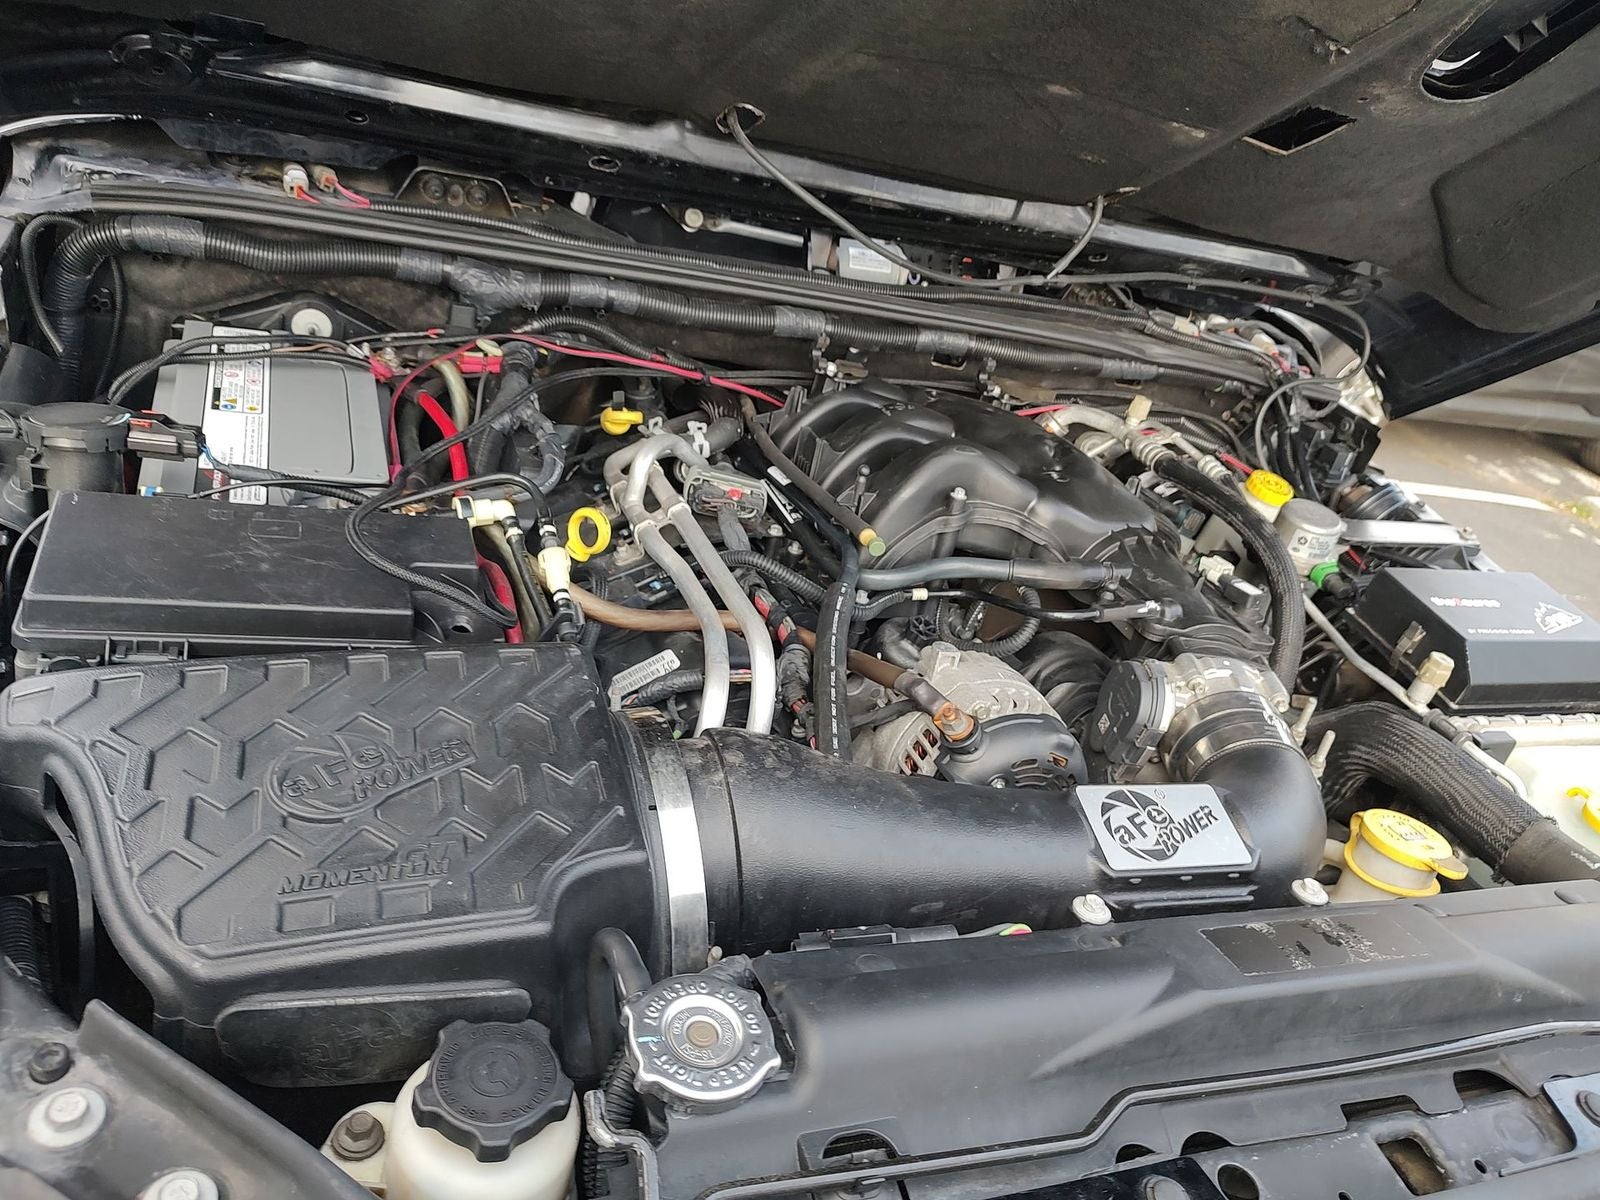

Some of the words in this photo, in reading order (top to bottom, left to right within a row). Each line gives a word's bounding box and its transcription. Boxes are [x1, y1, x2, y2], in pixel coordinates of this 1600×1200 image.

[282, 745, 385, 798] aFe
[352, 738, 469, 801] POWER
[1113, 807, 1169, 845] aFe
[1157, 804, 1219, 853] POWER
[276, 857, 451, 895] MOMENTUM
[662, 981, 709, 1000] OPEN
[714, 985, 748, 1011] NOT
[642, 996, 667, 1027] HOT
[744, 1012, 763, 1035] DO
[652, 1054, 704, 1088] TIGHT
[708, 1056, 755, 1088] KEEP
